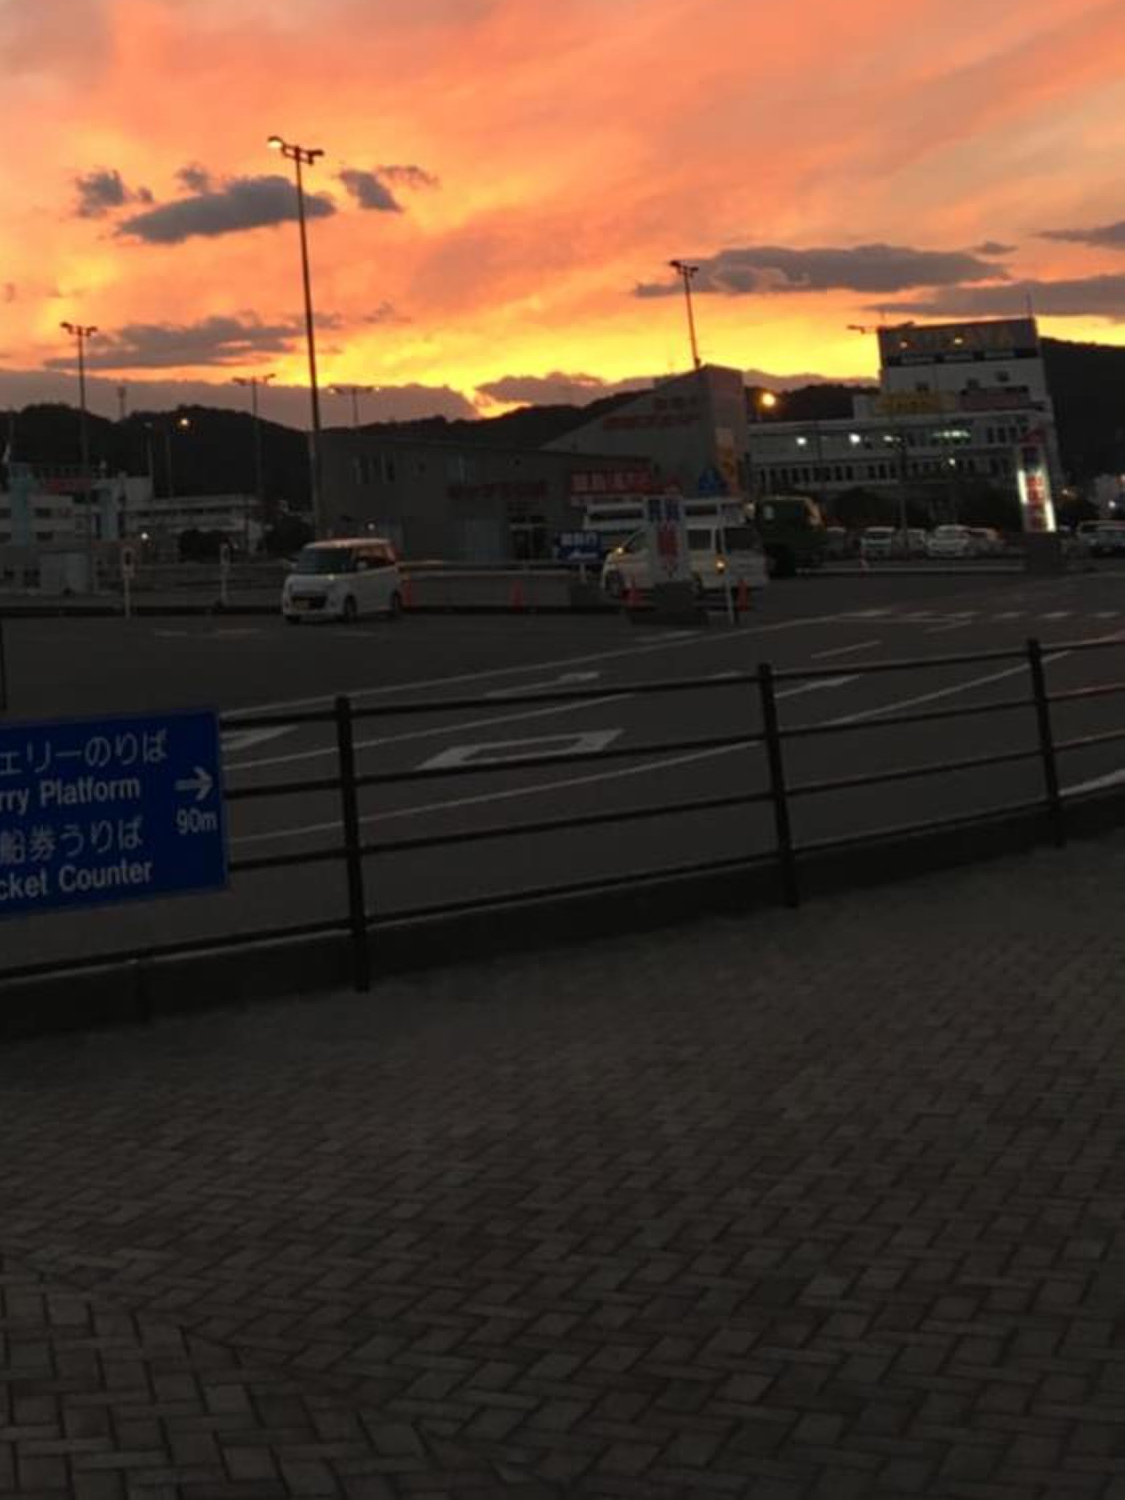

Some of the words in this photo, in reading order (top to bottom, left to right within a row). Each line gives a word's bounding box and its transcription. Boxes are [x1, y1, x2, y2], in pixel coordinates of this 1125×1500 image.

[40, 776, 141, 808] Platform
[176, 808, 218, 834] 90m
[58, 857, 154, 893] Counter
